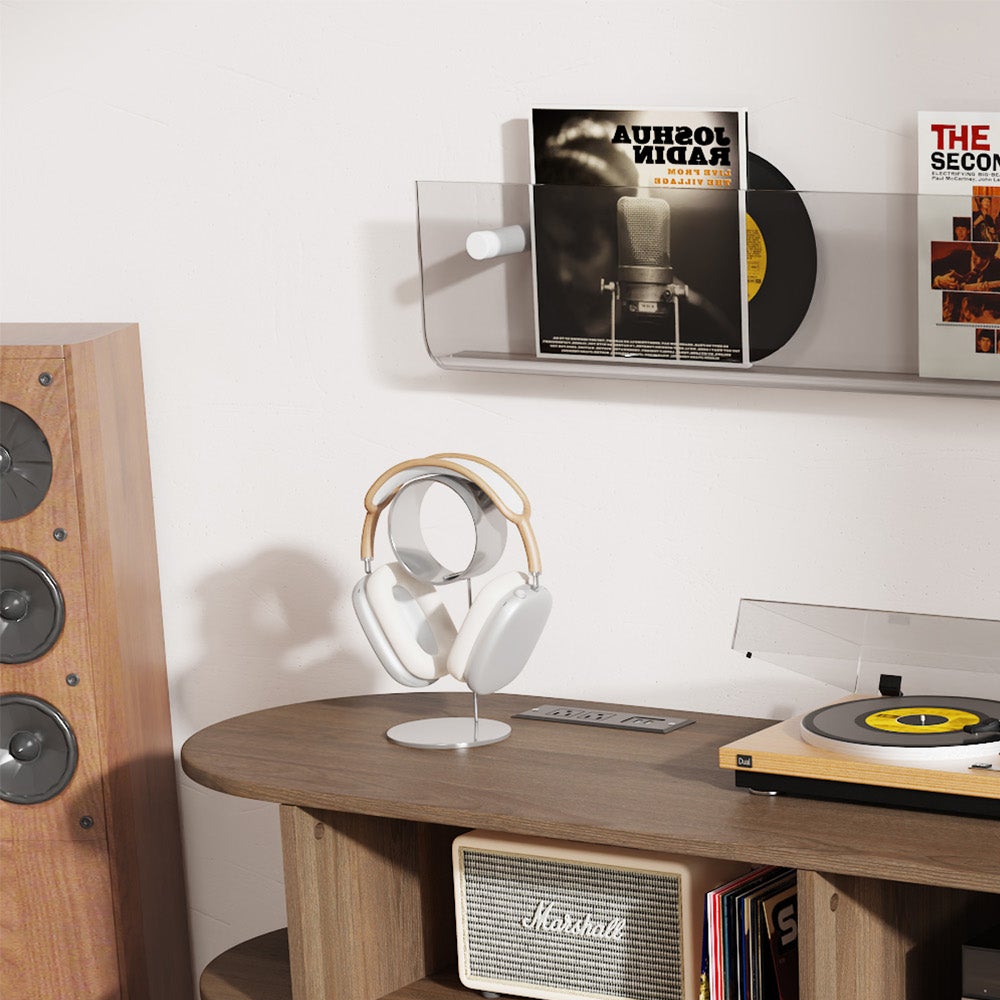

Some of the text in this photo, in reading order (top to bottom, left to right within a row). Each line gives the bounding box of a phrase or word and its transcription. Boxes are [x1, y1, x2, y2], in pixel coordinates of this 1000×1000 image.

[931, 124, 990, 151] THE
[738, 757, 751, 766] Dual
[522, 900, 627, 940] Marshall
